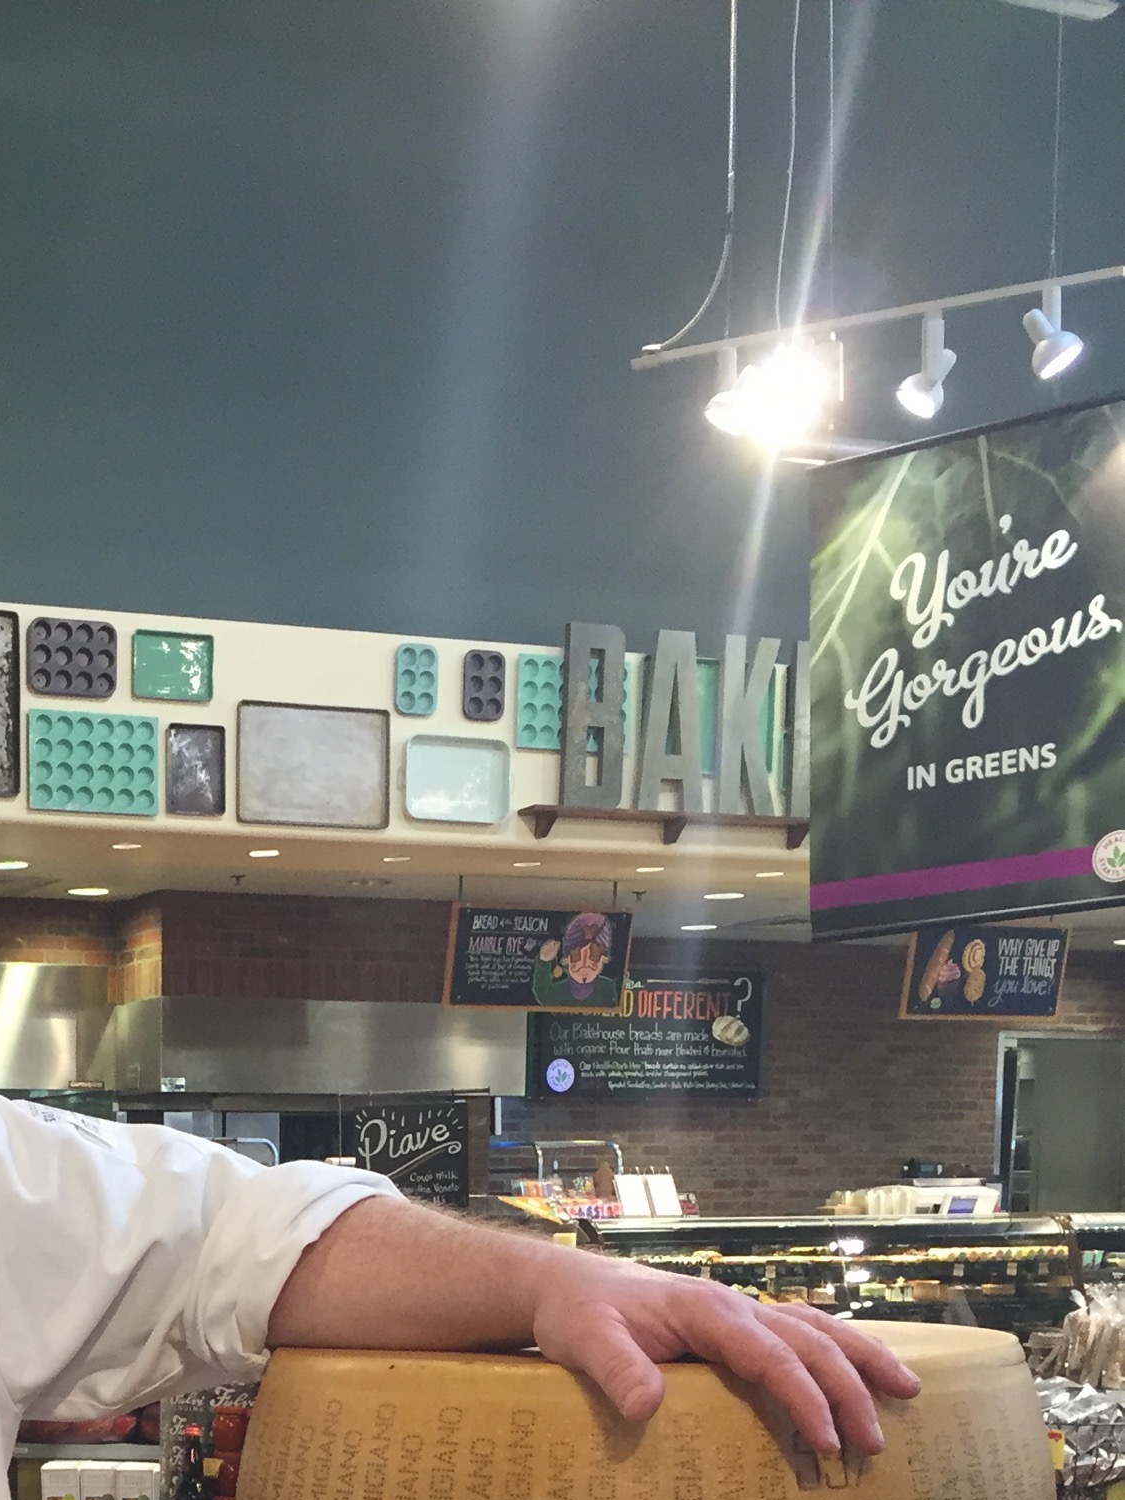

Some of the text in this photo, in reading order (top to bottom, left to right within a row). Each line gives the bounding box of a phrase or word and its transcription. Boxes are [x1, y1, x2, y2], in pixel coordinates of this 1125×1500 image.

[889, 513, 1078, 648] You're
[845, 594, 1123, 748] Gorgeous
[907, 742, 1057, 790] IN GREENS
[472, 914, 549, 932] BREAD SEASON
[997, 938, 1060, 958] WHY GIVE UP
[998, 957, 1057, 978] THE THINGS
[987, 978, 1018, 1007] you
[628, 1022, 663, 1041] breads
[357, 1118, 450, 1171] Piave
